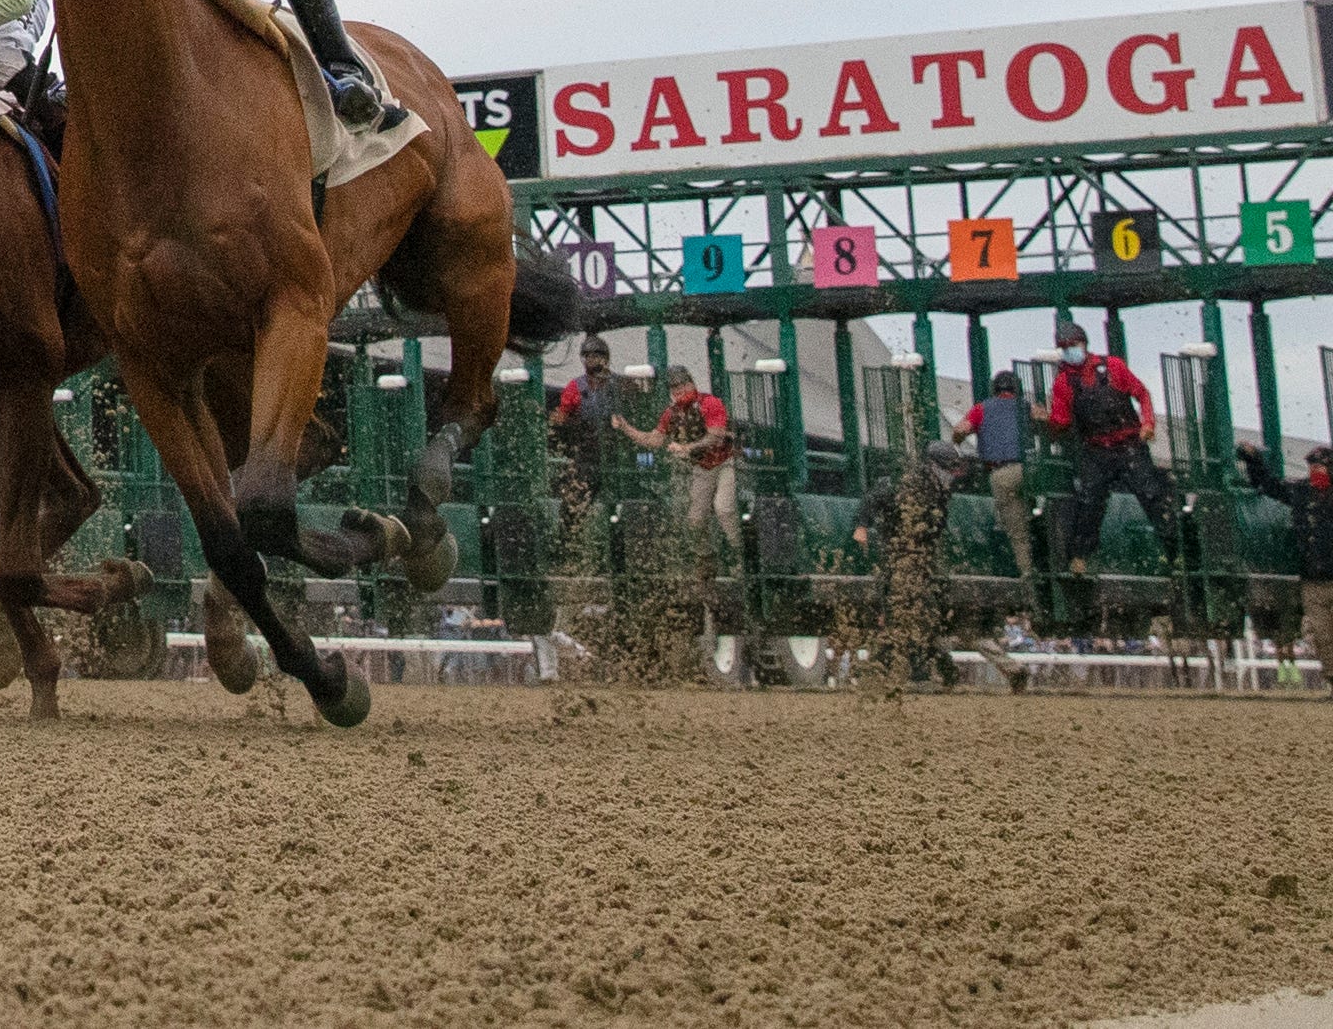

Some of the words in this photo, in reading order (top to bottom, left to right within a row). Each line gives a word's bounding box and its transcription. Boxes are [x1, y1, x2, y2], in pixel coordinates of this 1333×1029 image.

[553, 25, 1304, 158] SARATOGA
[971, 230, 994, 268] 7
[1111, 217, 1141, 262] 6
[1266, 210, 1294, 254] 5
[567, 250, 608, 289] 10
[702, 244, 724, 282] 9
[835, 237, 857, 275] 8
